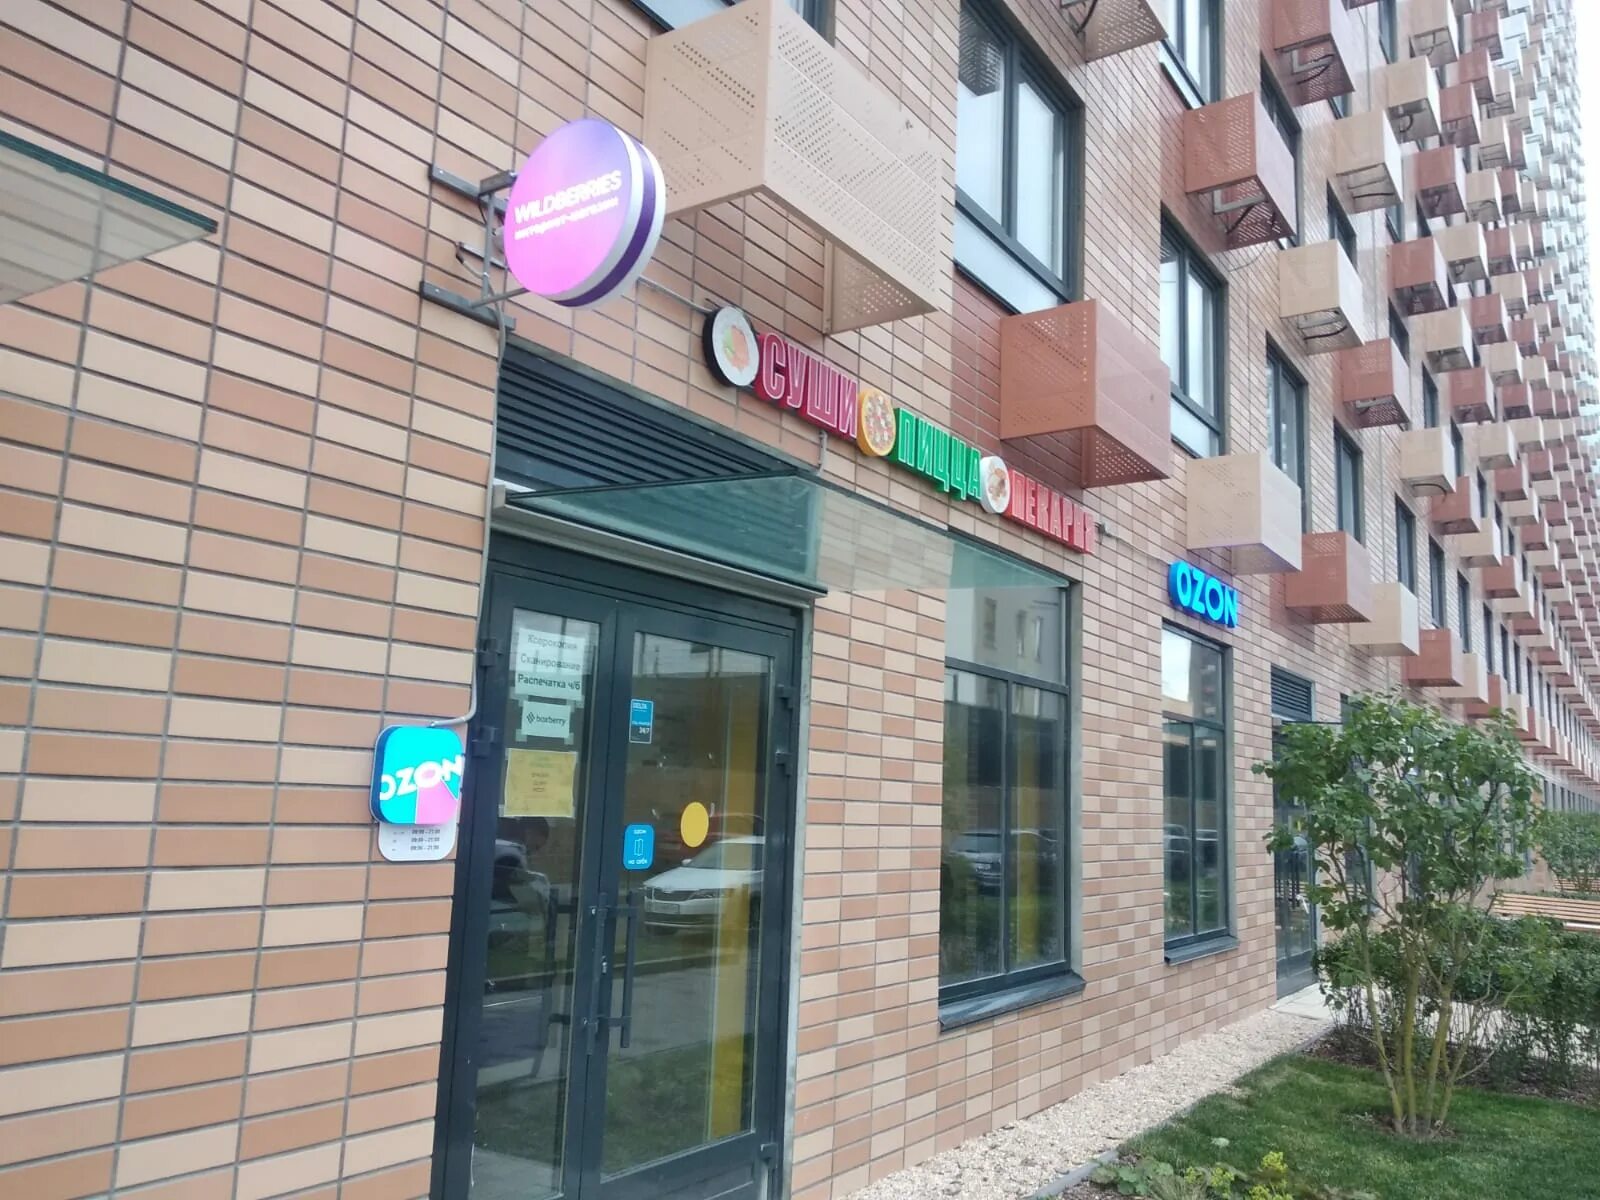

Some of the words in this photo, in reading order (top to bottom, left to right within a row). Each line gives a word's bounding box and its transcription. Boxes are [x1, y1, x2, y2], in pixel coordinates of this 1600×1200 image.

[514, 169, 622, 225] WILDBERRIES
[762, 332, 859, 439] СУШИ
[898, 406, 983, 501] ПИЦЦА
[1011, 468, 1096, 556] ПЕКАРНЯ
[1176, 561, 1238, 627] OZON
[517, 673, 566, 690] Распечатка
[567, 680, 581, 690] ч/б
[535, 714, 566, 727] boxberry
[380, 754, 464, 801] OZON
